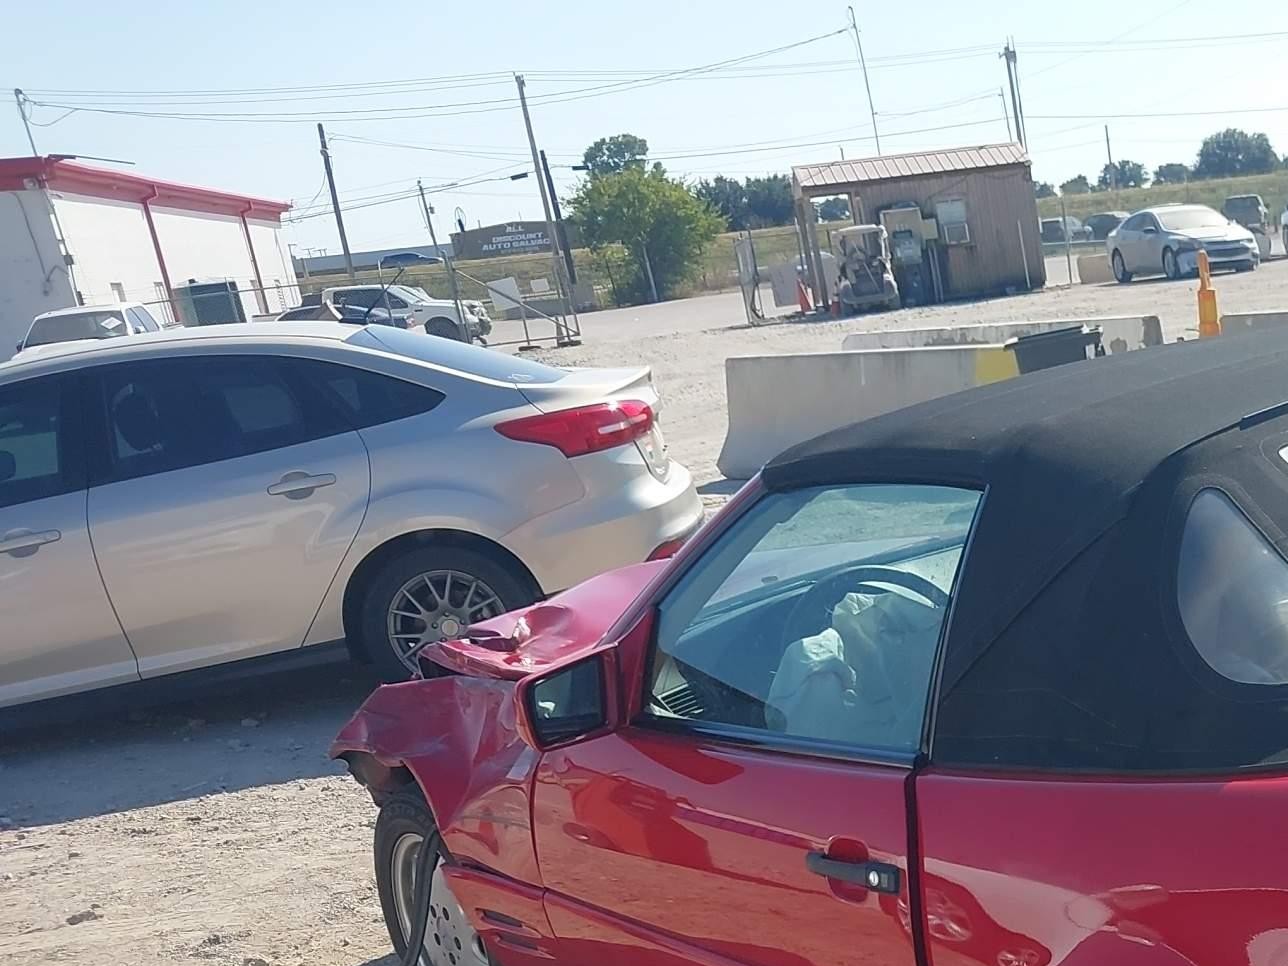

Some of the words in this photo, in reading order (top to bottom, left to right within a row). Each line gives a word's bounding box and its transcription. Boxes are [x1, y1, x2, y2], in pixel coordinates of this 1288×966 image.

[505, 224, 525, 233] ALL
[491, 232, 544, 243] DISCOUNT
[482, 242, 511, 251] AUTO
[512, 238, 551, 248] SALVAG
